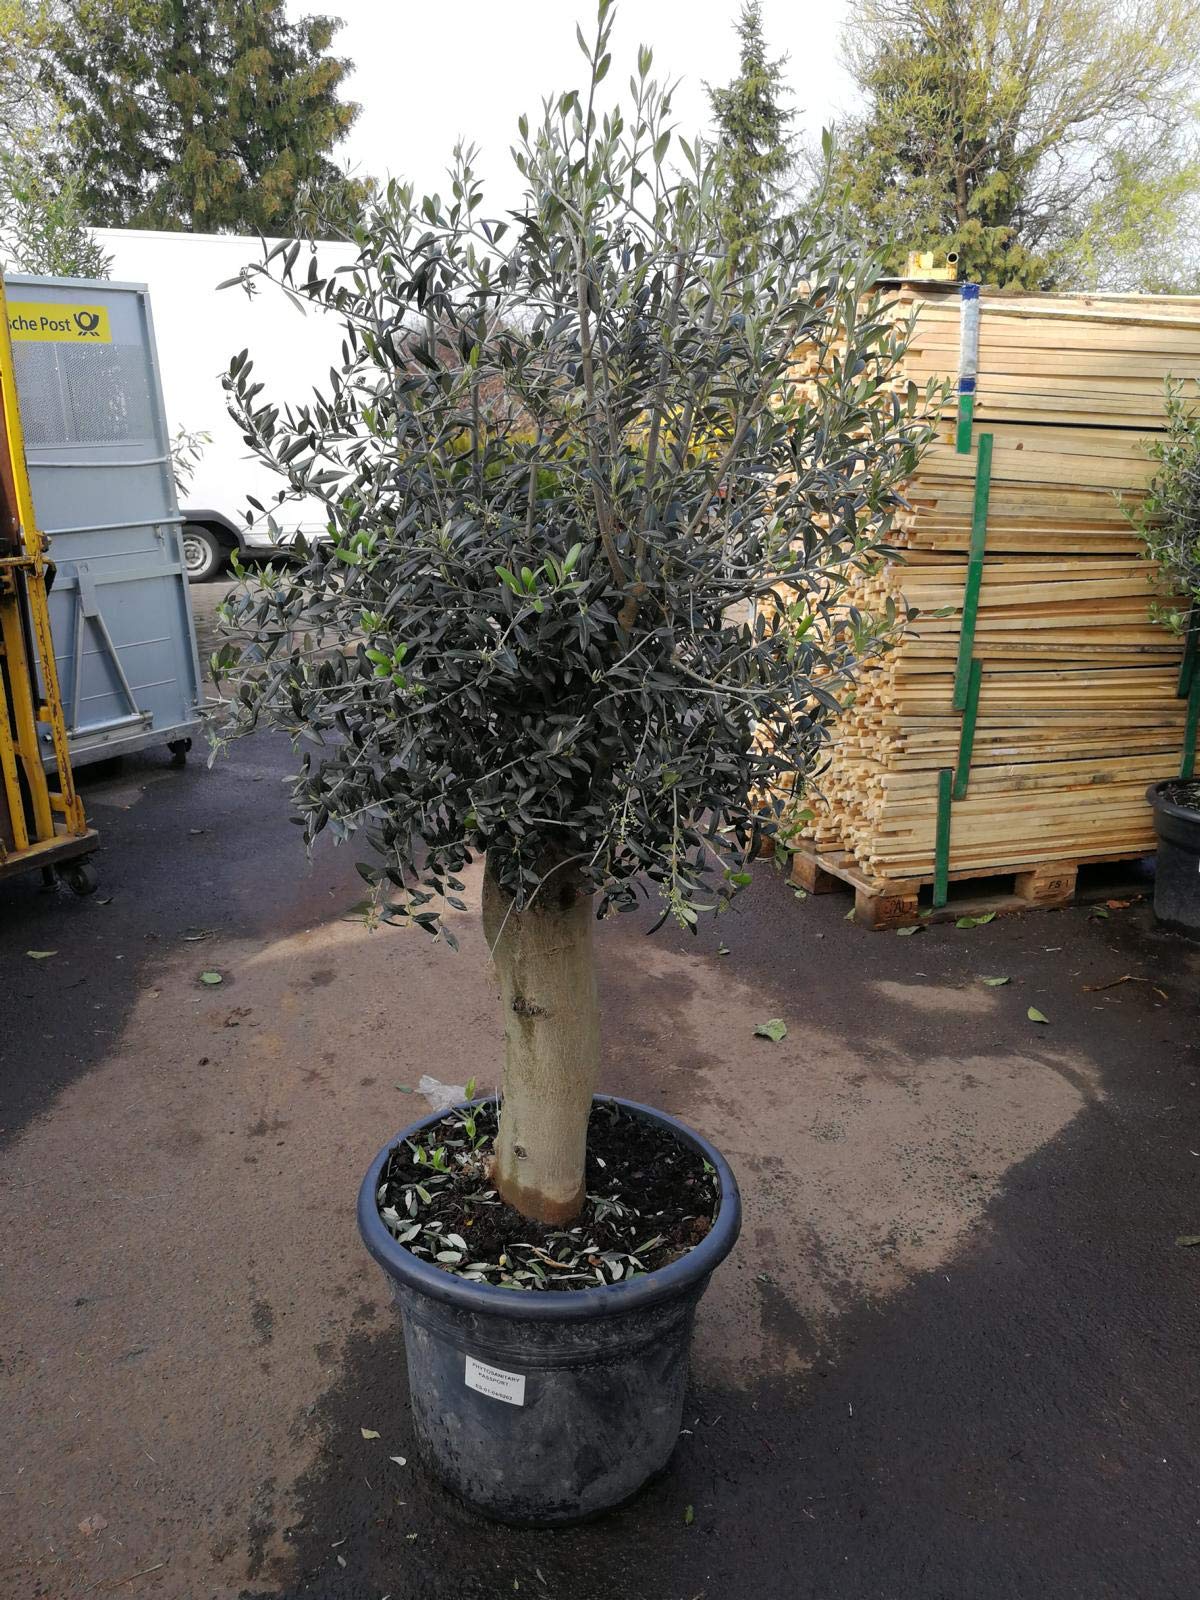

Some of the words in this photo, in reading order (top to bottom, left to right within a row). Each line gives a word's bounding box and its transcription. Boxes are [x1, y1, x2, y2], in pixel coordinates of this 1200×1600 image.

[40, 317, 71, 332] Post
[472, 1362, 520, 1383] PHYTOSANITARY
[478, 1372, 509, 1387] PASSPORT
